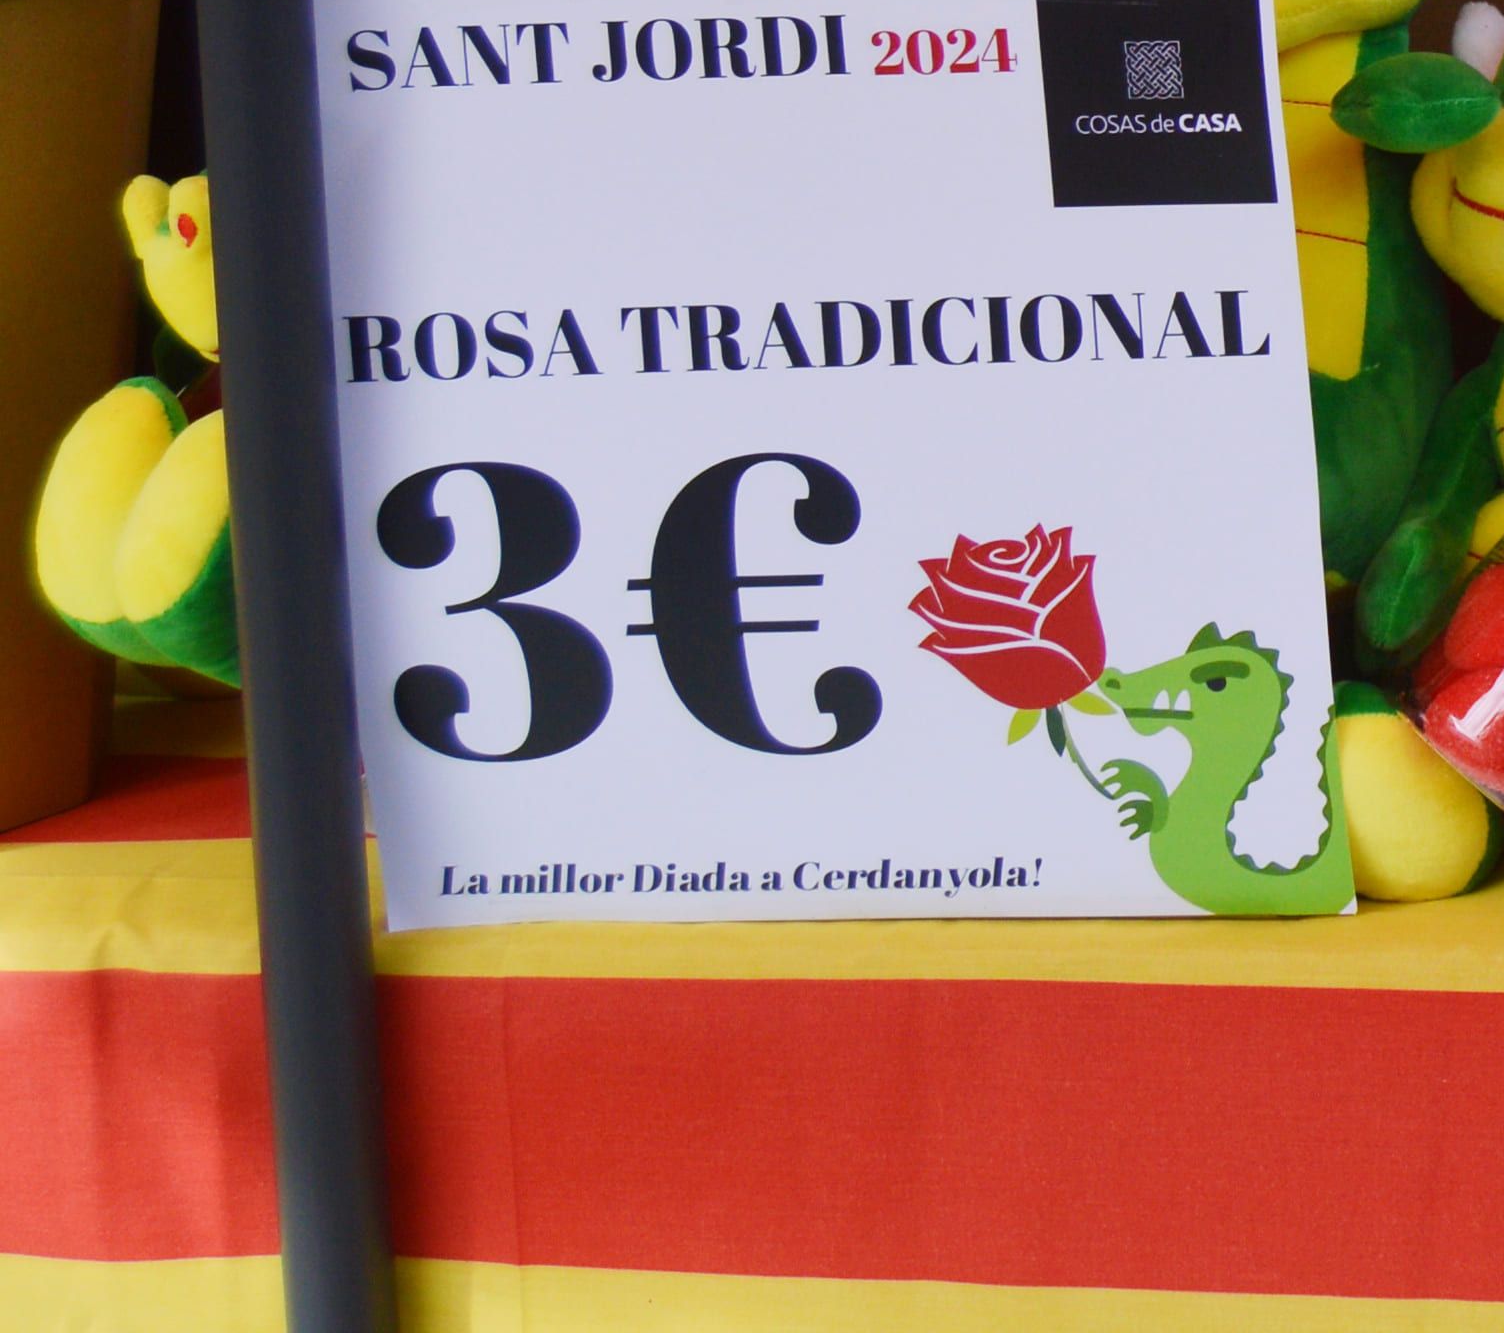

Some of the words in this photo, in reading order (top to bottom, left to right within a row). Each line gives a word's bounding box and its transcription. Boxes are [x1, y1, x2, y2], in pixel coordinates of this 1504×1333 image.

[346, 21, 570, 93] SANT
[591, 14, 848, 83] JORDI
[870, 25, 1018, 77] 2024
[1074, 112, 1147, 136] COSAS
[1150, 112, 1175, 136] de
[1177, 111, 1243, 135] CASA
[342, 306, 598, 384] ROSA
[620, 289, 1272, 375] TRADICIONAL
[375, 450, 883, 764] 3€
[439, 863, 492, 897] La
[498, 863, 626, 896] millor
[631, 860, 753, 895] Diada
[760, 868, 785, 892] a
[791, 855, 1043, 899] Cerdanyola!
